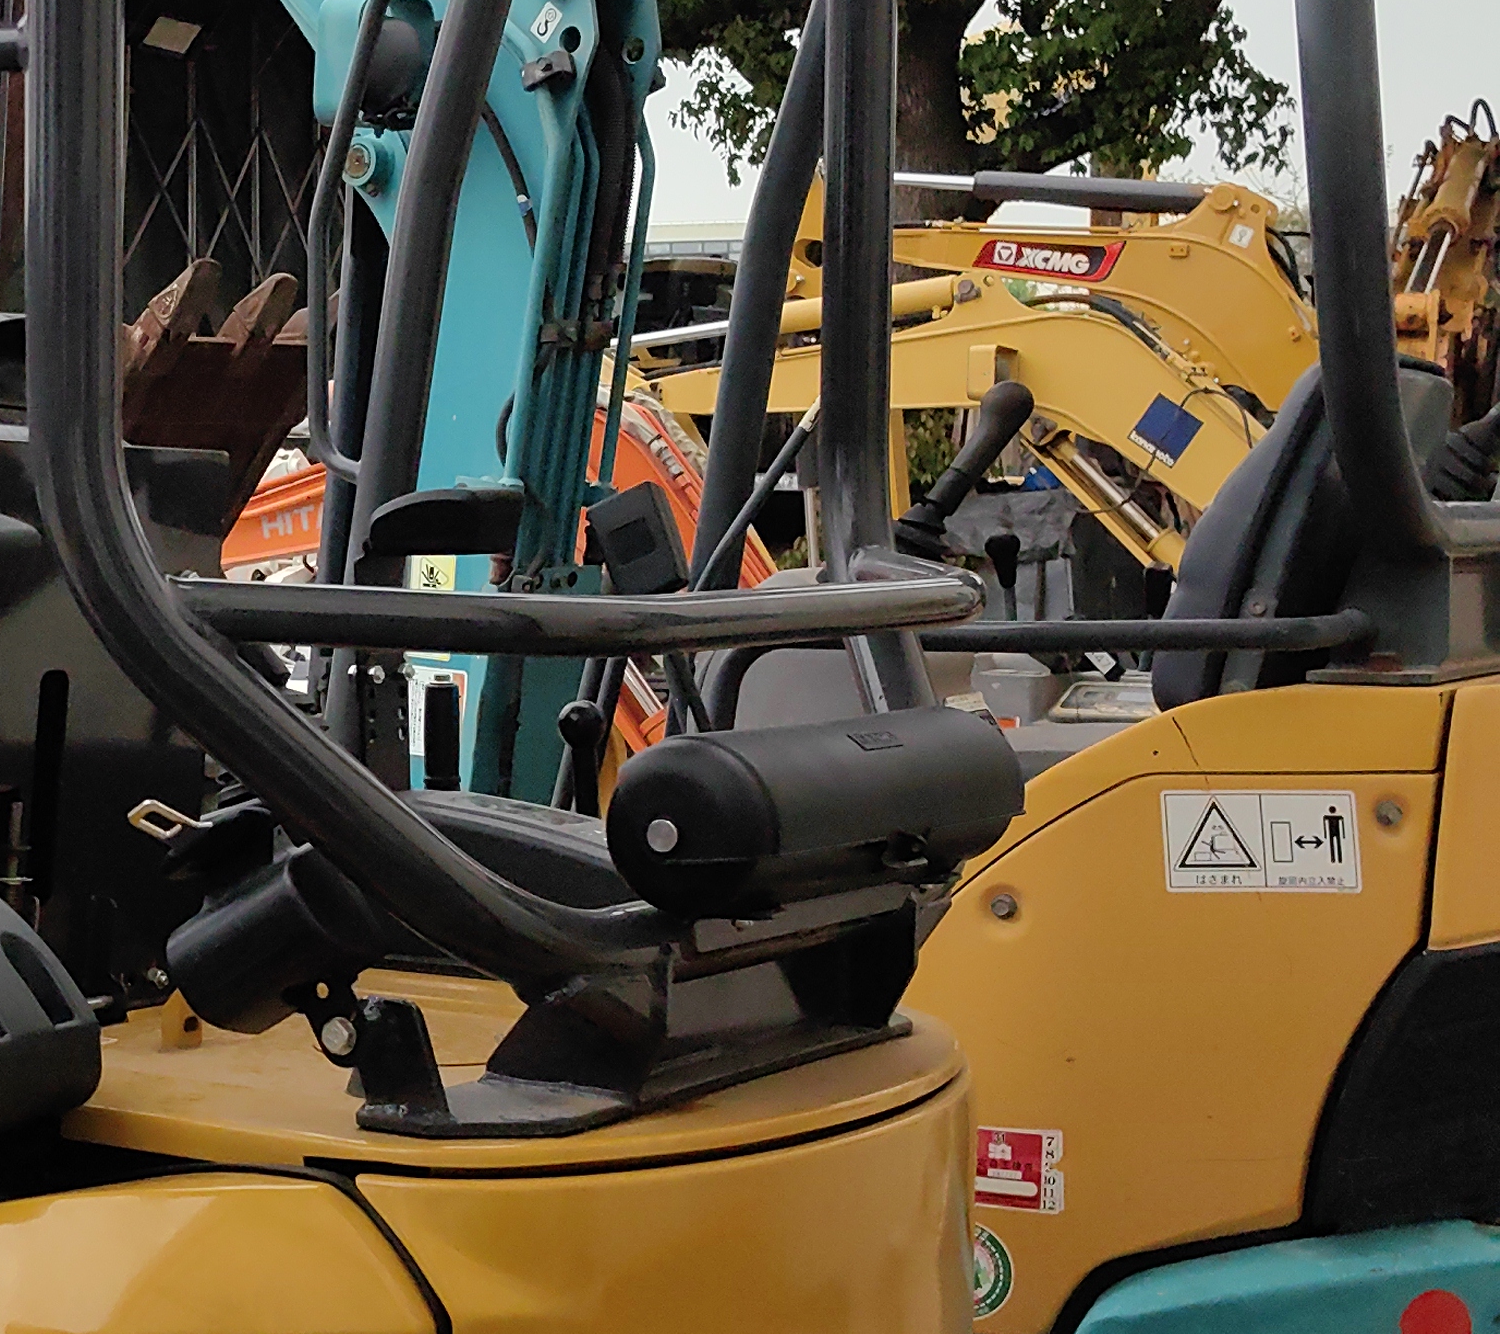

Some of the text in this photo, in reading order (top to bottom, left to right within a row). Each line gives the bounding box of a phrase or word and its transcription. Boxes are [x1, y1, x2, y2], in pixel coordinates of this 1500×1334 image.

[1016, 246, 1090, 275] XCMG
[1195, 873, 1243, 885] はさまれ
